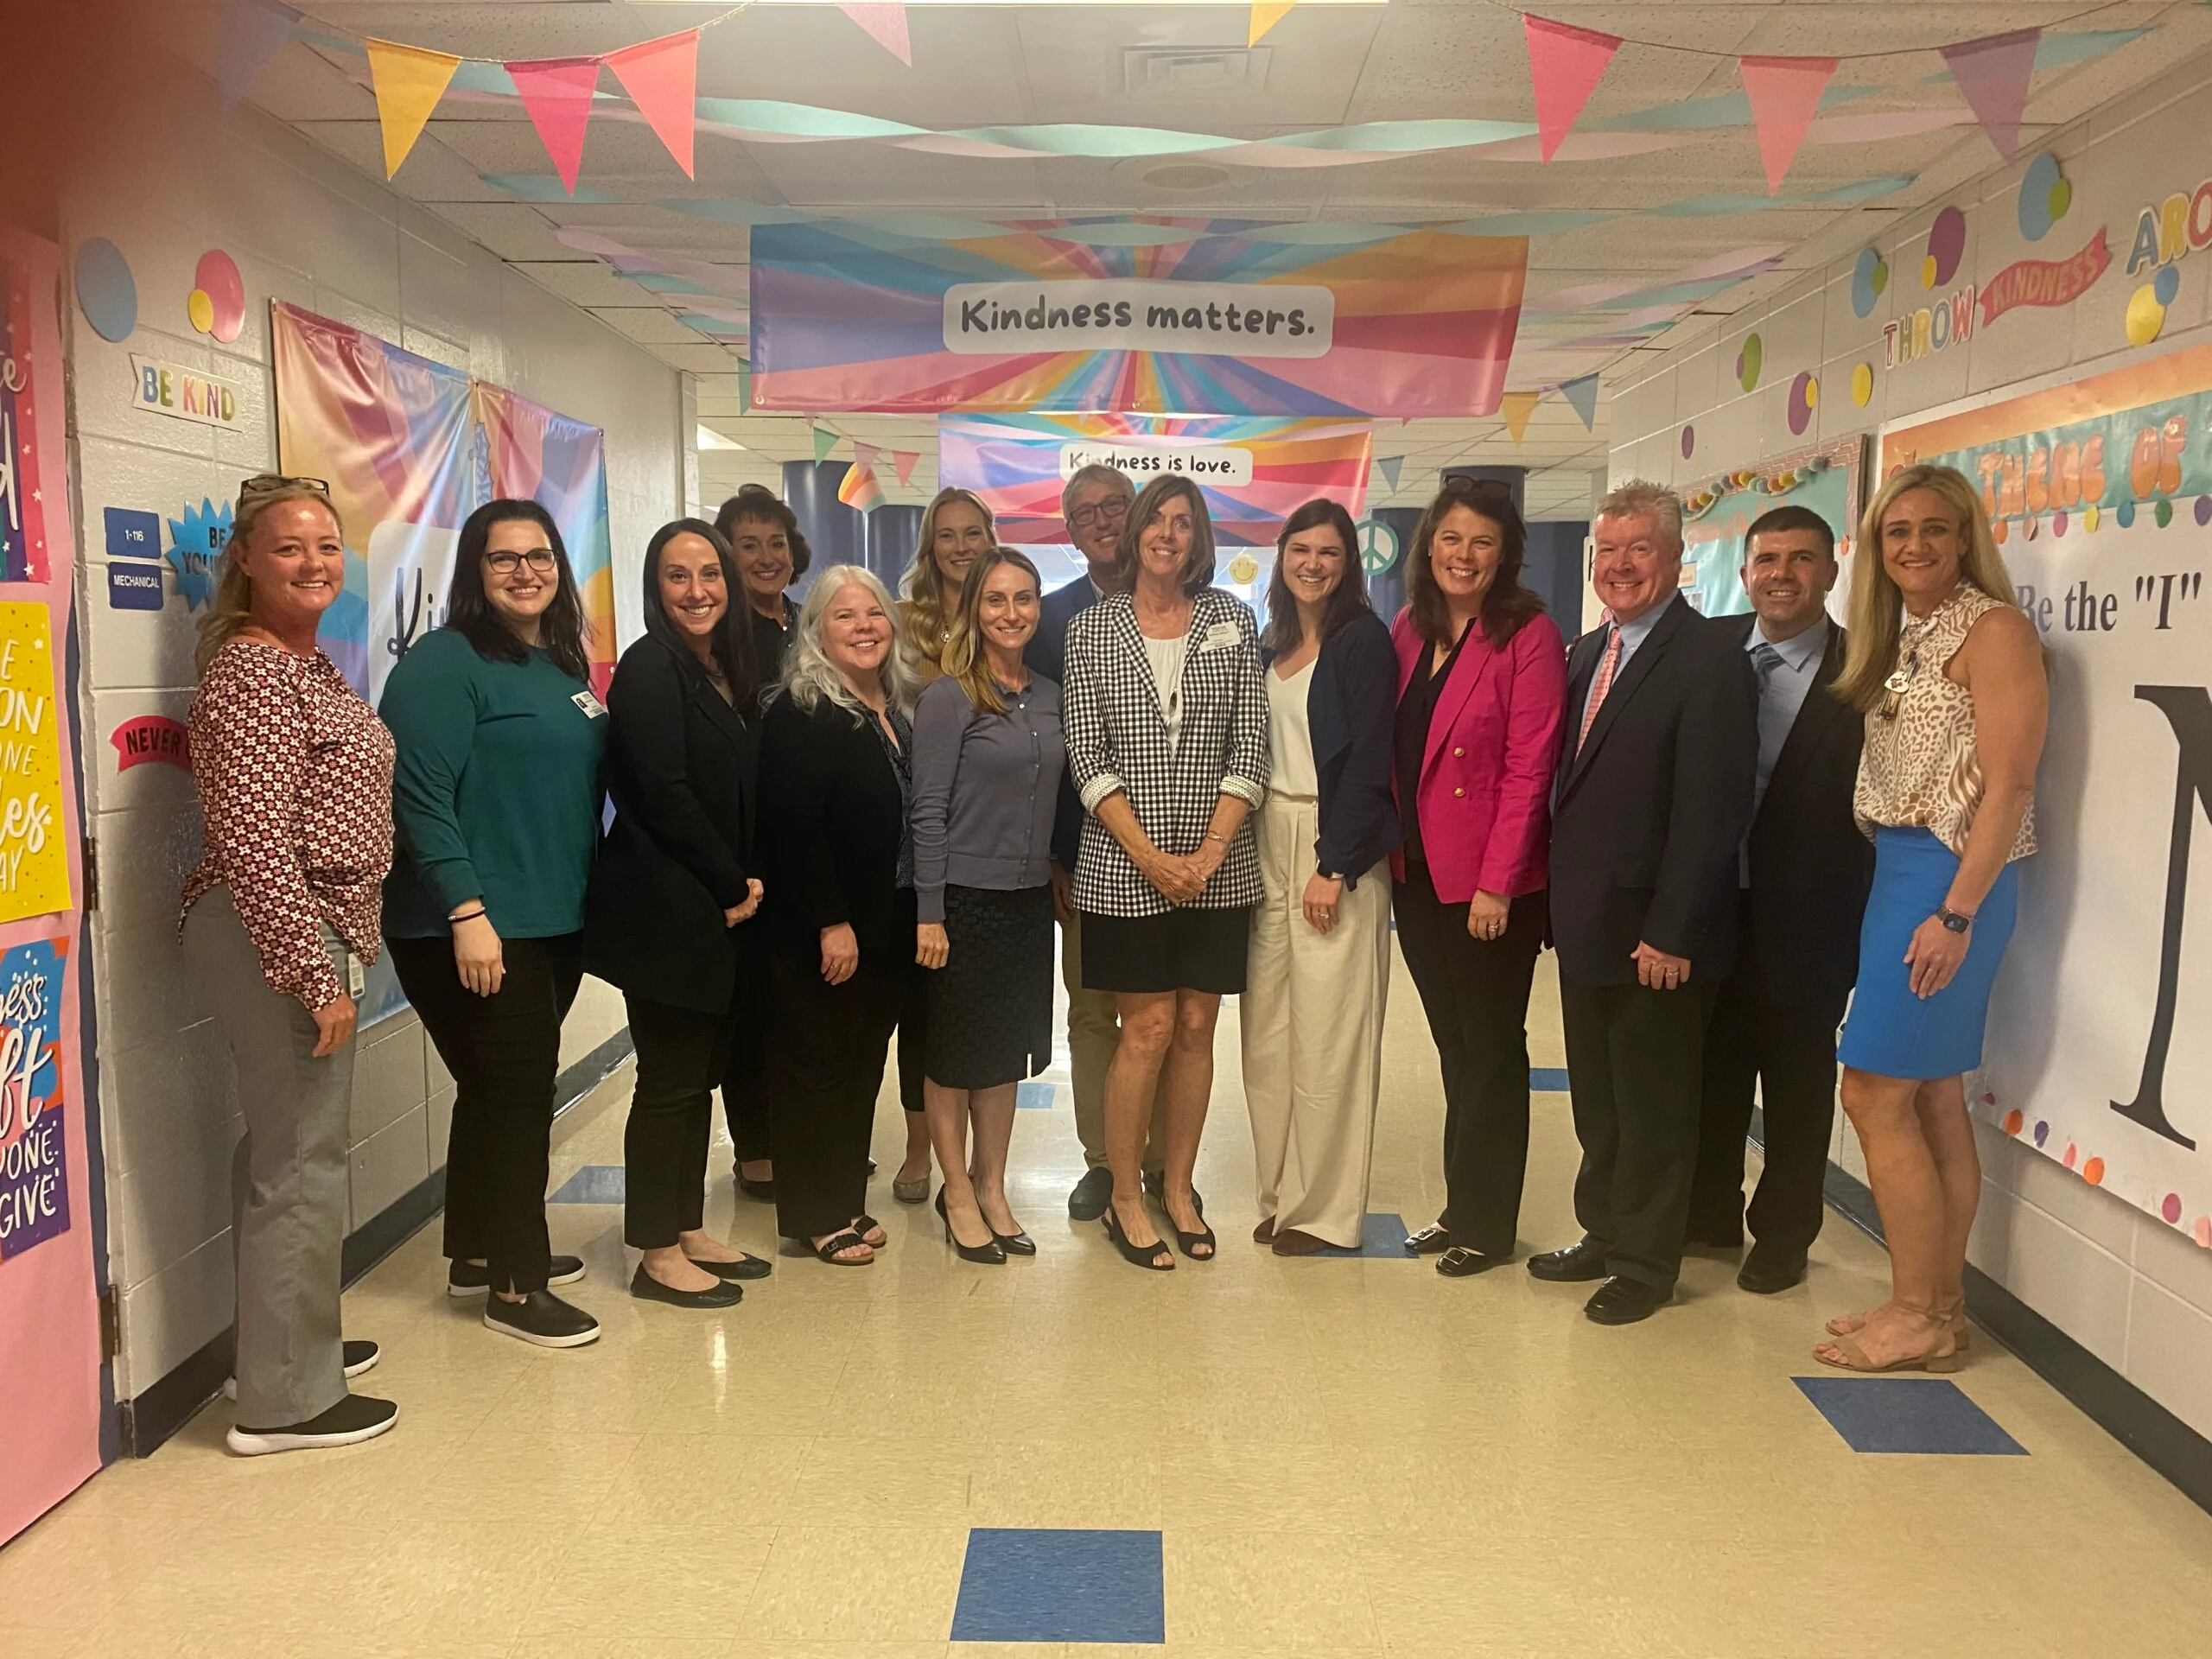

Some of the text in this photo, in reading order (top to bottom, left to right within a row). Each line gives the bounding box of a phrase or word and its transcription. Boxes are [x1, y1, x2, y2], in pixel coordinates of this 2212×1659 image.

[961, 295, 1315, 336] Kindness matters.
[1884, 285, 1974, 368] THROW
[1993, 245, 2098, 311] KINDNESS
[143, 366, 235, 422] BE KIND
[1168, 454, 1182, 471] is
[1190, 455, 1236, 474] love.
[1977, 416, 2188, 517] THEME OF
[125, 529, 144, 542] 1-116
[113, 575, 160, 588] MECHANICAL
[2016, 572, 2202, 633] Be the "I"
[125, 727, 181, 756] NEVER
[0, 1173, 56, 1238] GIVE
